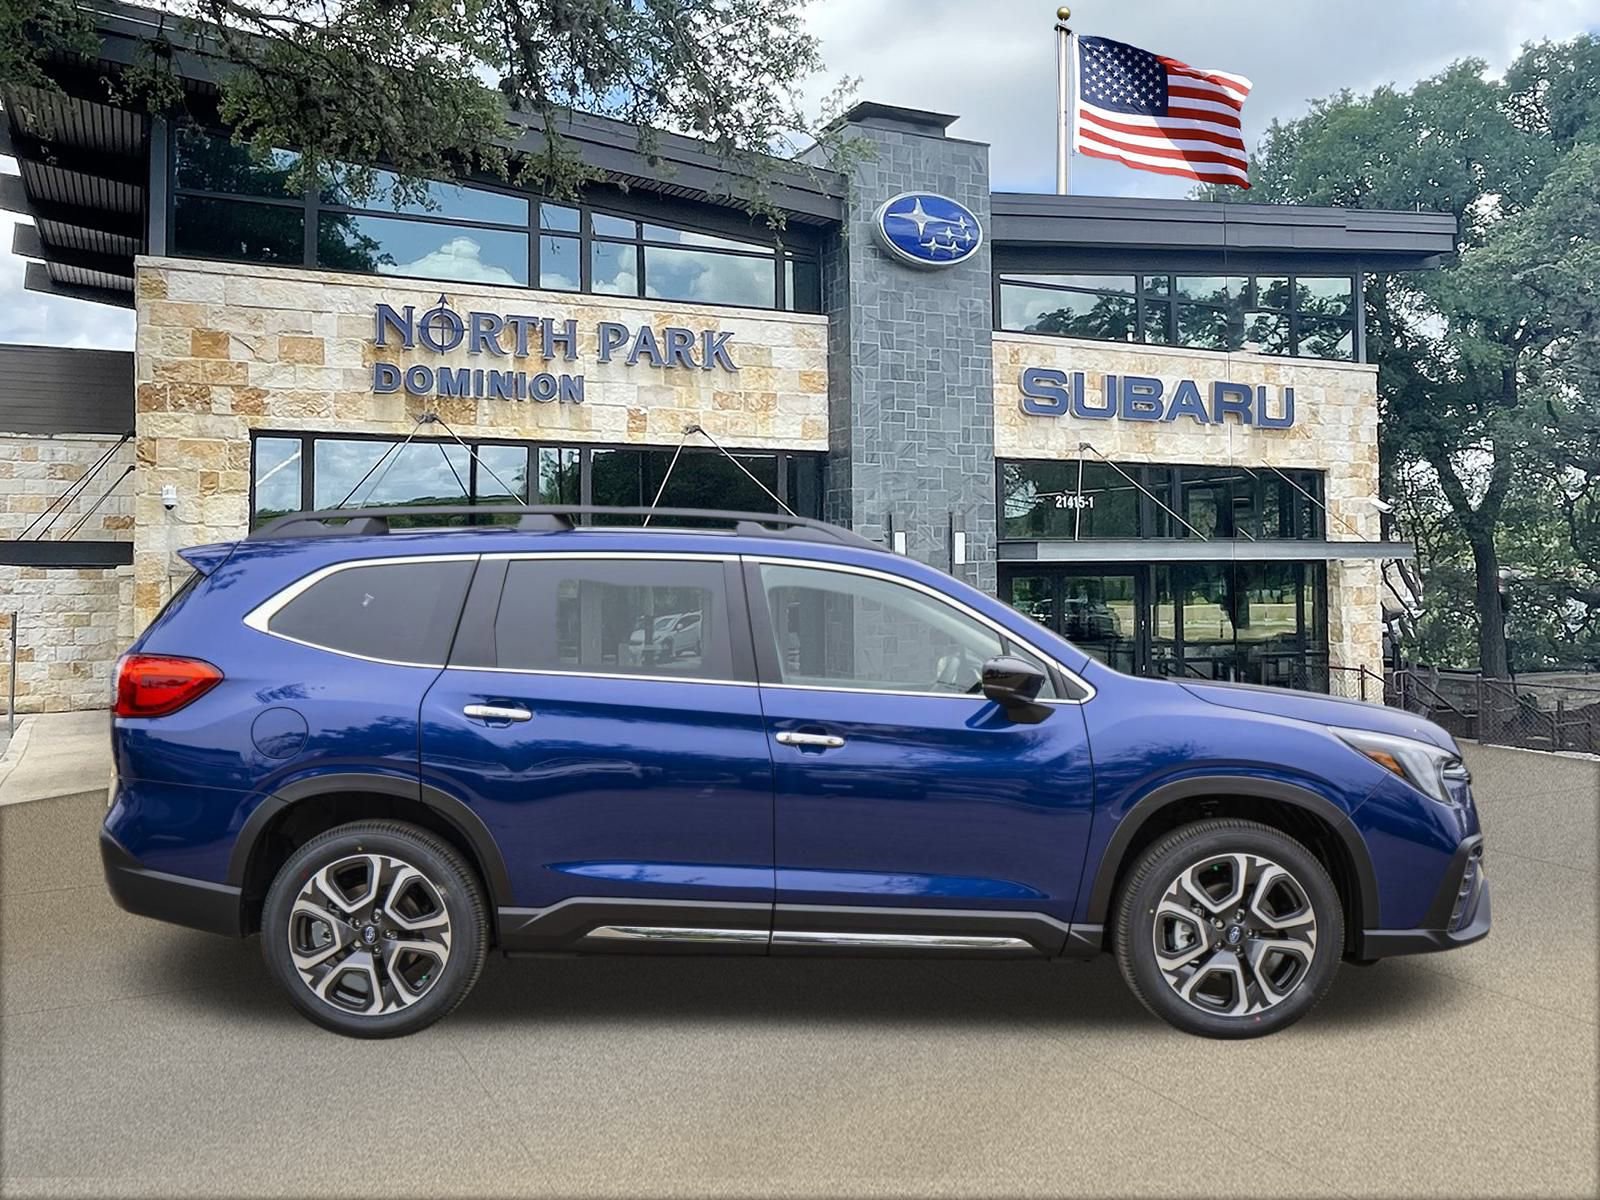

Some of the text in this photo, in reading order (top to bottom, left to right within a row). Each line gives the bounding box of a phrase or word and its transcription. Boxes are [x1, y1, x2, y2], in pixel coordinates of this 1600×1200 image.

[375, 298, 740, 373] NORTH PARK
[373, 362, 584, 404] DOMINION
[1019, 367, 1294, 429] SUBARU
